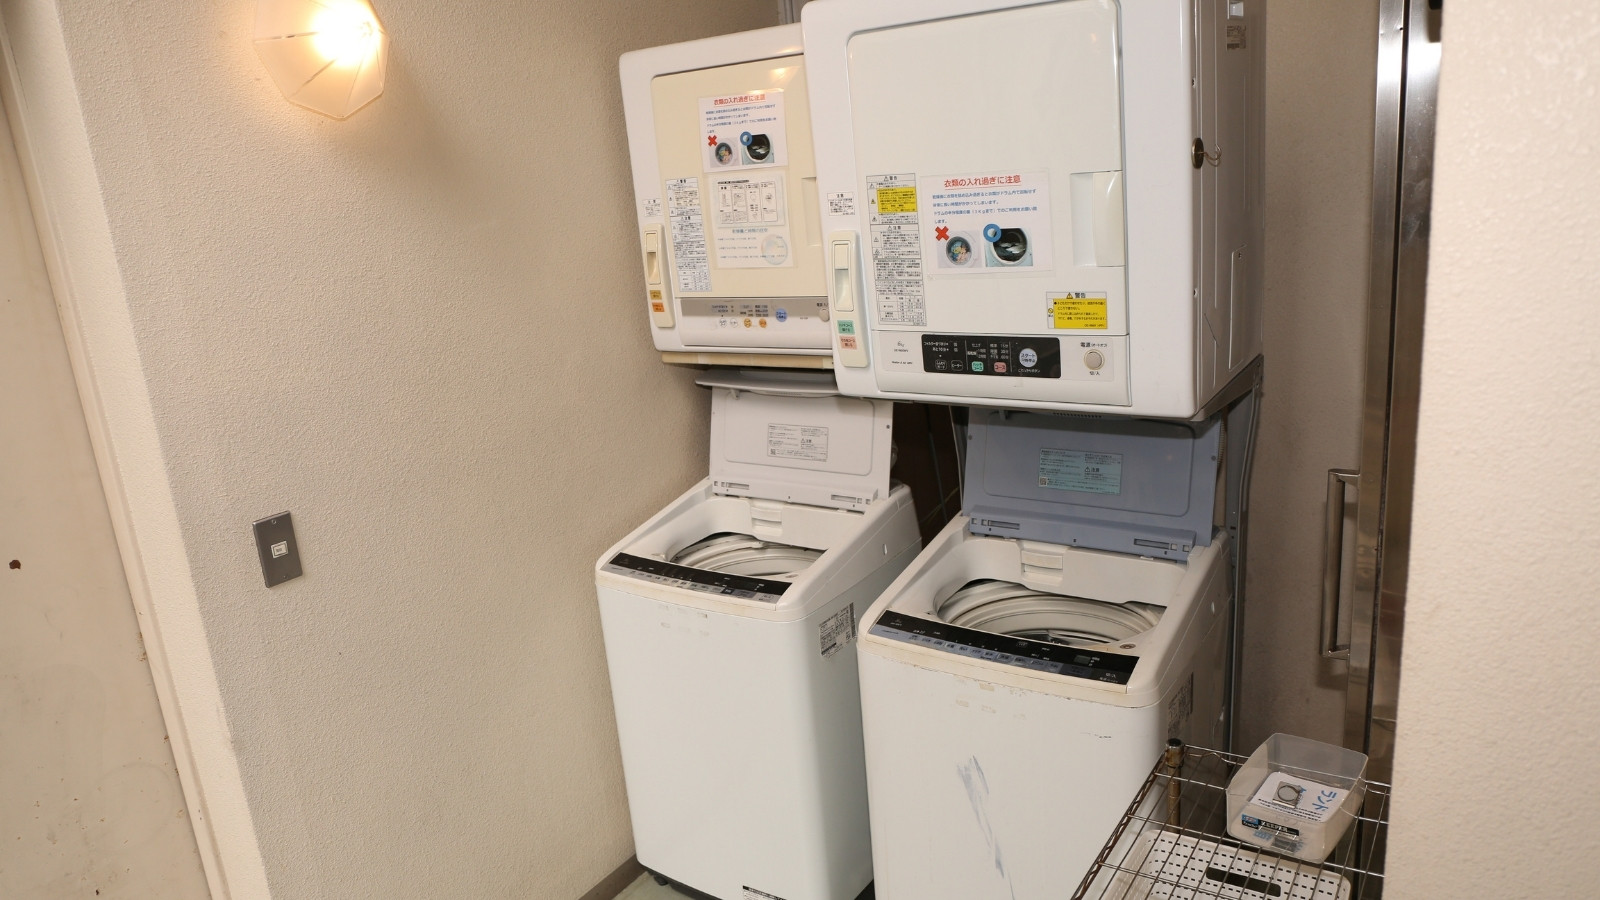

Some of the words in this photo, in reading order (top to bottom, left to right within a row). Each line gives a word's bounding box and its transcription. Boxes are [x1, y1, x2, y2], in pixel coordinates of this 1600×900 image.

[944, 175, 1021, 187] 衣類の入れ過ぎに注意
